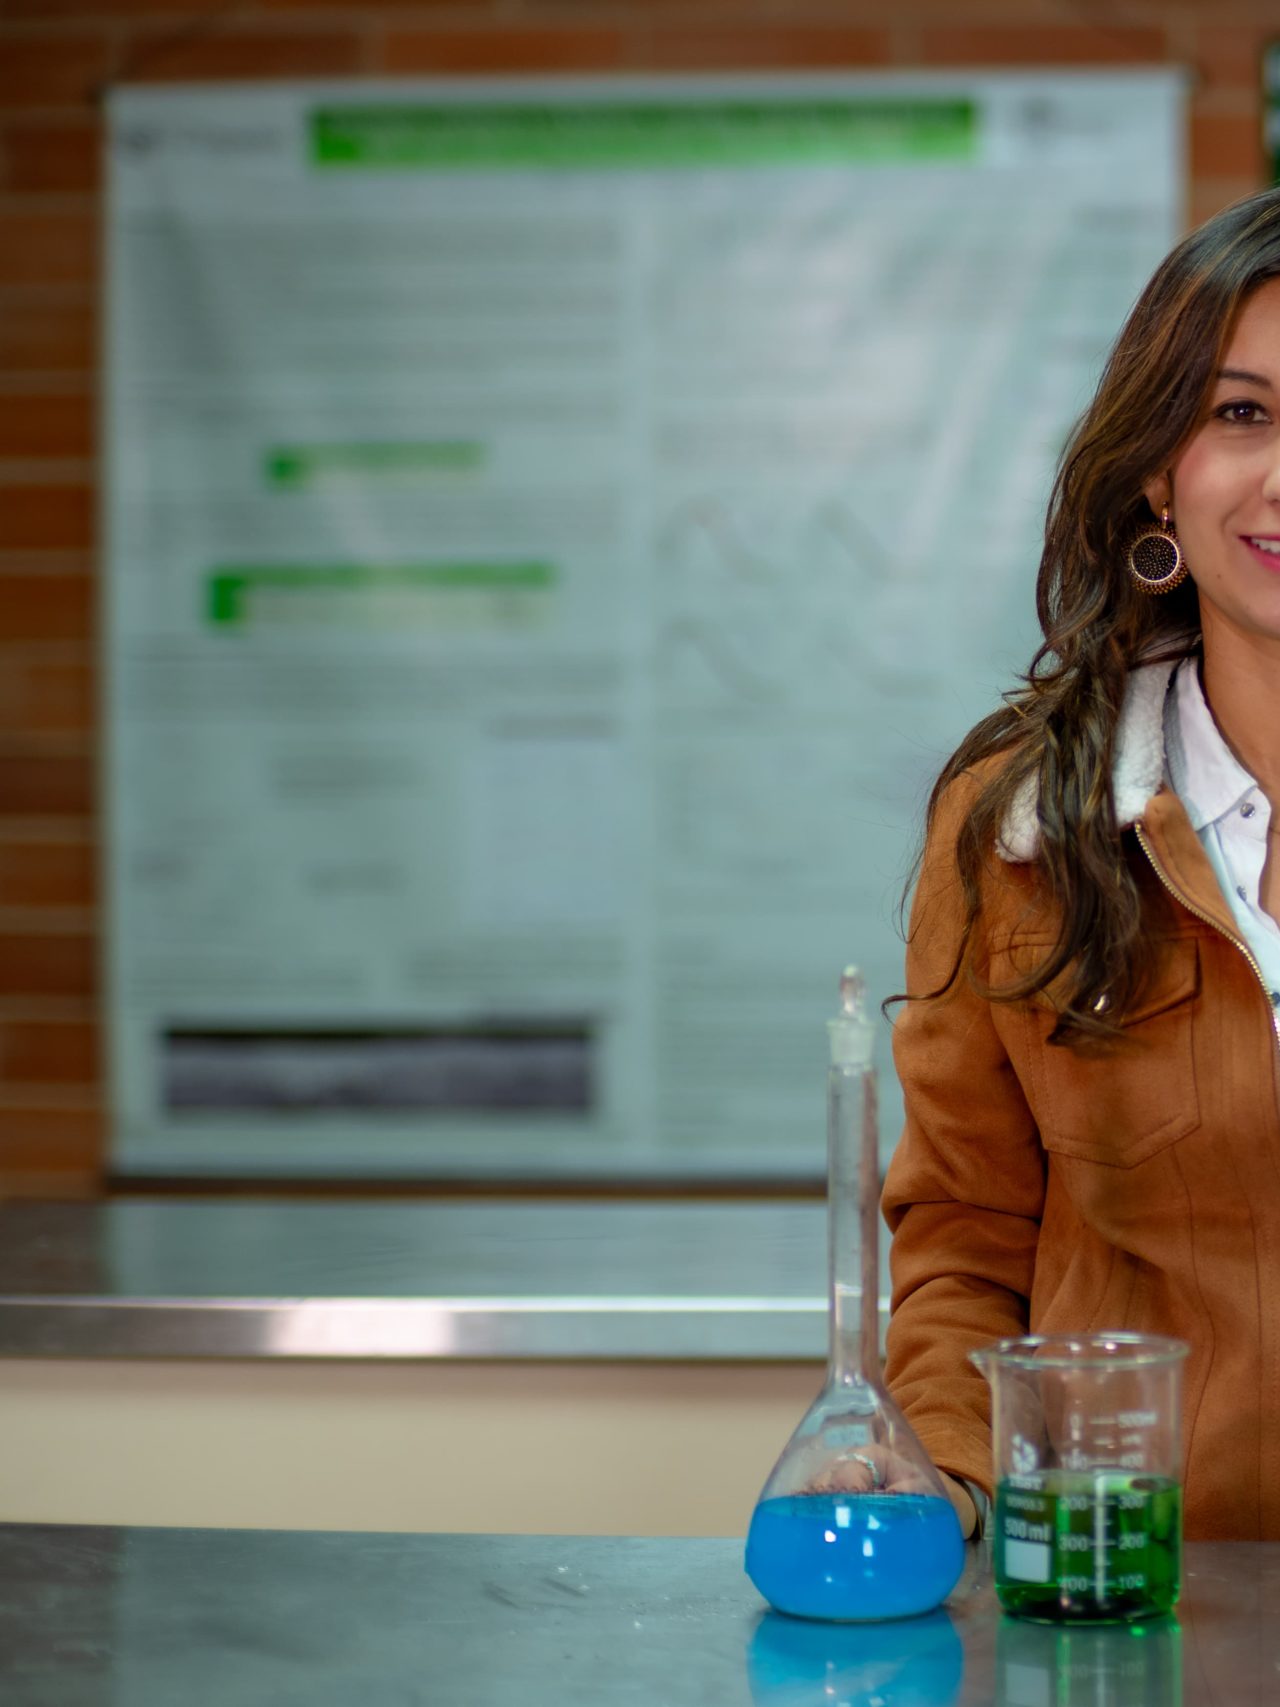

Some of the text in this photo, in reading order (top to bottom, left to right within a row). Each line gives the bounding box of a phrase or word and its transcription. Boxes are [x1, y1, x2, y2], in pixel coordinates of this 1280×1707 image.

[1058, 1496, 1088, 1511] 200
[1118, 1495, 1144, 1510] 300
[1004, 1516, 1051, 1541] 500 ml
[1058, 1534, 1088, 1552] 300
[1118, 1532, 1145, 1551] 200
[1118, 1573, 1144, 1590] 100
